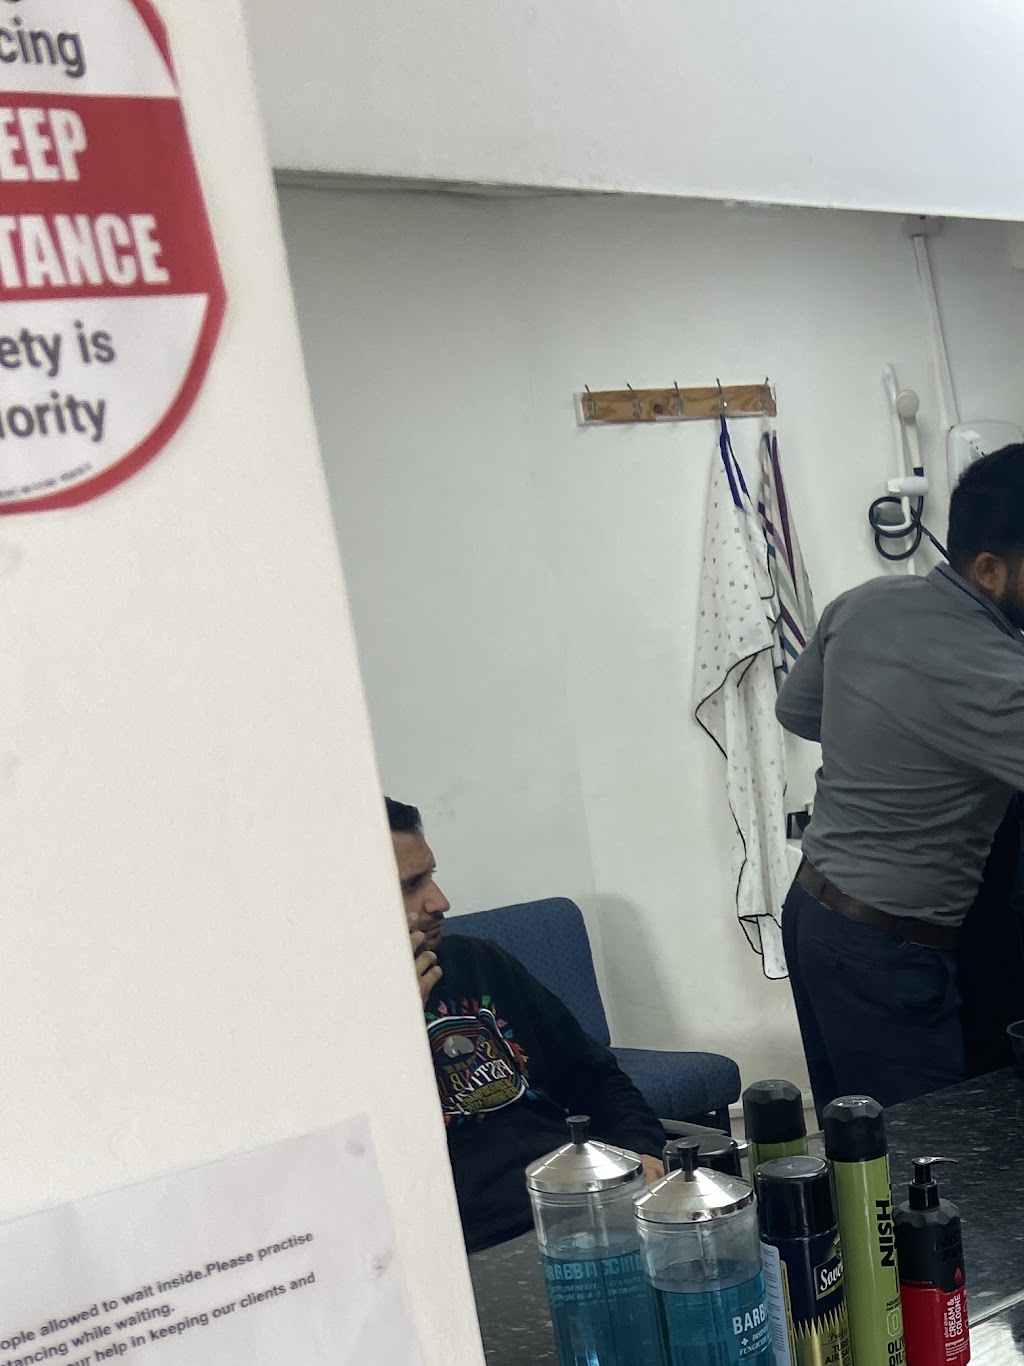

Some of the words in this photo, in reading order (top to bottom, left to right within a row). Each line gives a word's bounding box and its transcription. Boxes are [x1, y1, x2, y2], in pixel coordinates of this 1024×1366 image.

[74, 321, 116, 364] is
[875, 1200, 895, 1267] NISH
[41, 1305, 98, 1338] allowed
[104, 1301, 118, 1315] to
[122, 1285, 154, 1309] wait
[158, 1253, 254, 1296] inside.Please
[259, 1232, 313, 1263] practise
[947, 1298, 957, 1306] &
[72, 1326, 111, 1350] while
[116, 1304, 176, 1334] waiting.
[97, 1343, 127, 1364] help
[133, 1336, 146, 1350] in
[150, 1313, 208, 1343] keeping
[213, 1303, 235, 1320] our
[240, 1283, 286, 1310] clients
[291, 1270, 315, 1291] and
[948, 1307, 957, 1339] CREAM
[955, 1294, 963, 1337] COLOGNE
